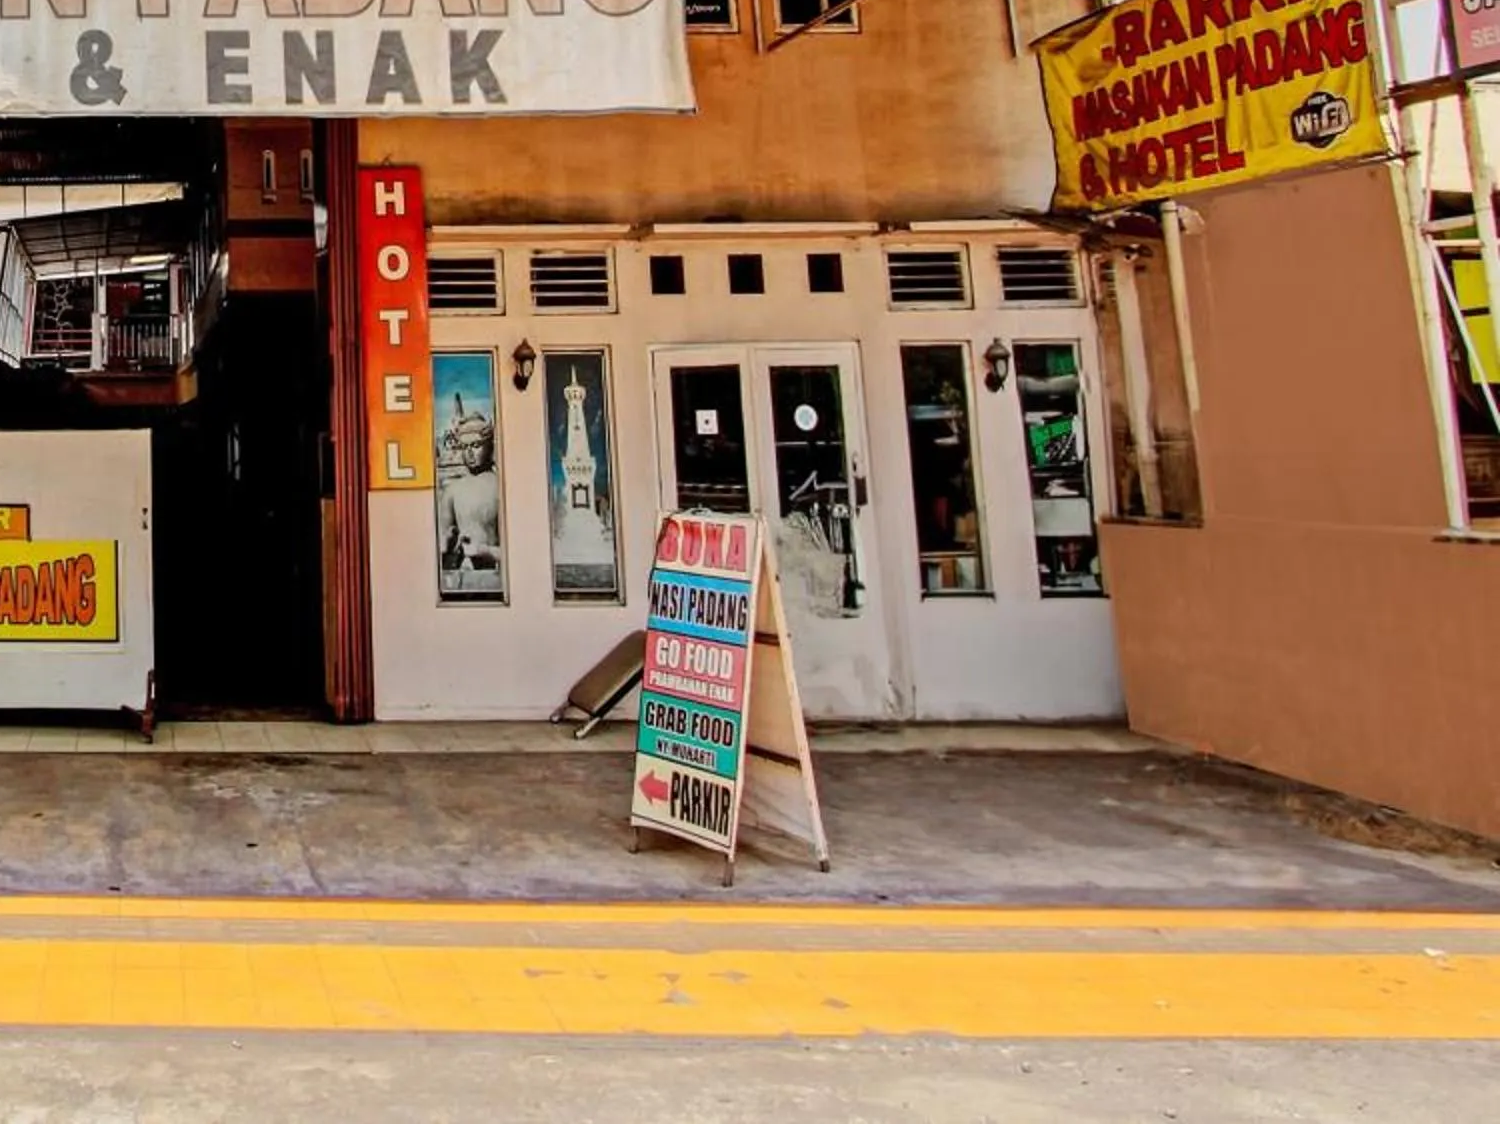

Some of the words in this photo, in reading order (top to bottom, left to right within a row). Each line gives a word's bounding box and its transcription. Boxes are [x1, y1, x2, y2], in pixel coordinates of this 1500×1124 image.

[68, 28, 129, 106] &
[207, 28, 509, 105] ENAK
[1072, 52, 1212, 141] MASAKAN
[1215, 0, 1368, 101] PADANG
[1109, 118, 1244, 194] HOTEL
[375, 181, 416, 480] HOTEL
[657, 517, 747, 572] BUKA
[651, 581, 684, 621] NASI
[687, 588, 748, 631] PADANG
[655, 636, 681, 669] GO
[684, 641, 734, 680] FOOD
[645, 701, 687, 735] GRAB
[691, 712, 734, 747] FOOD
[670, 771, 732, 836] PARKIR
